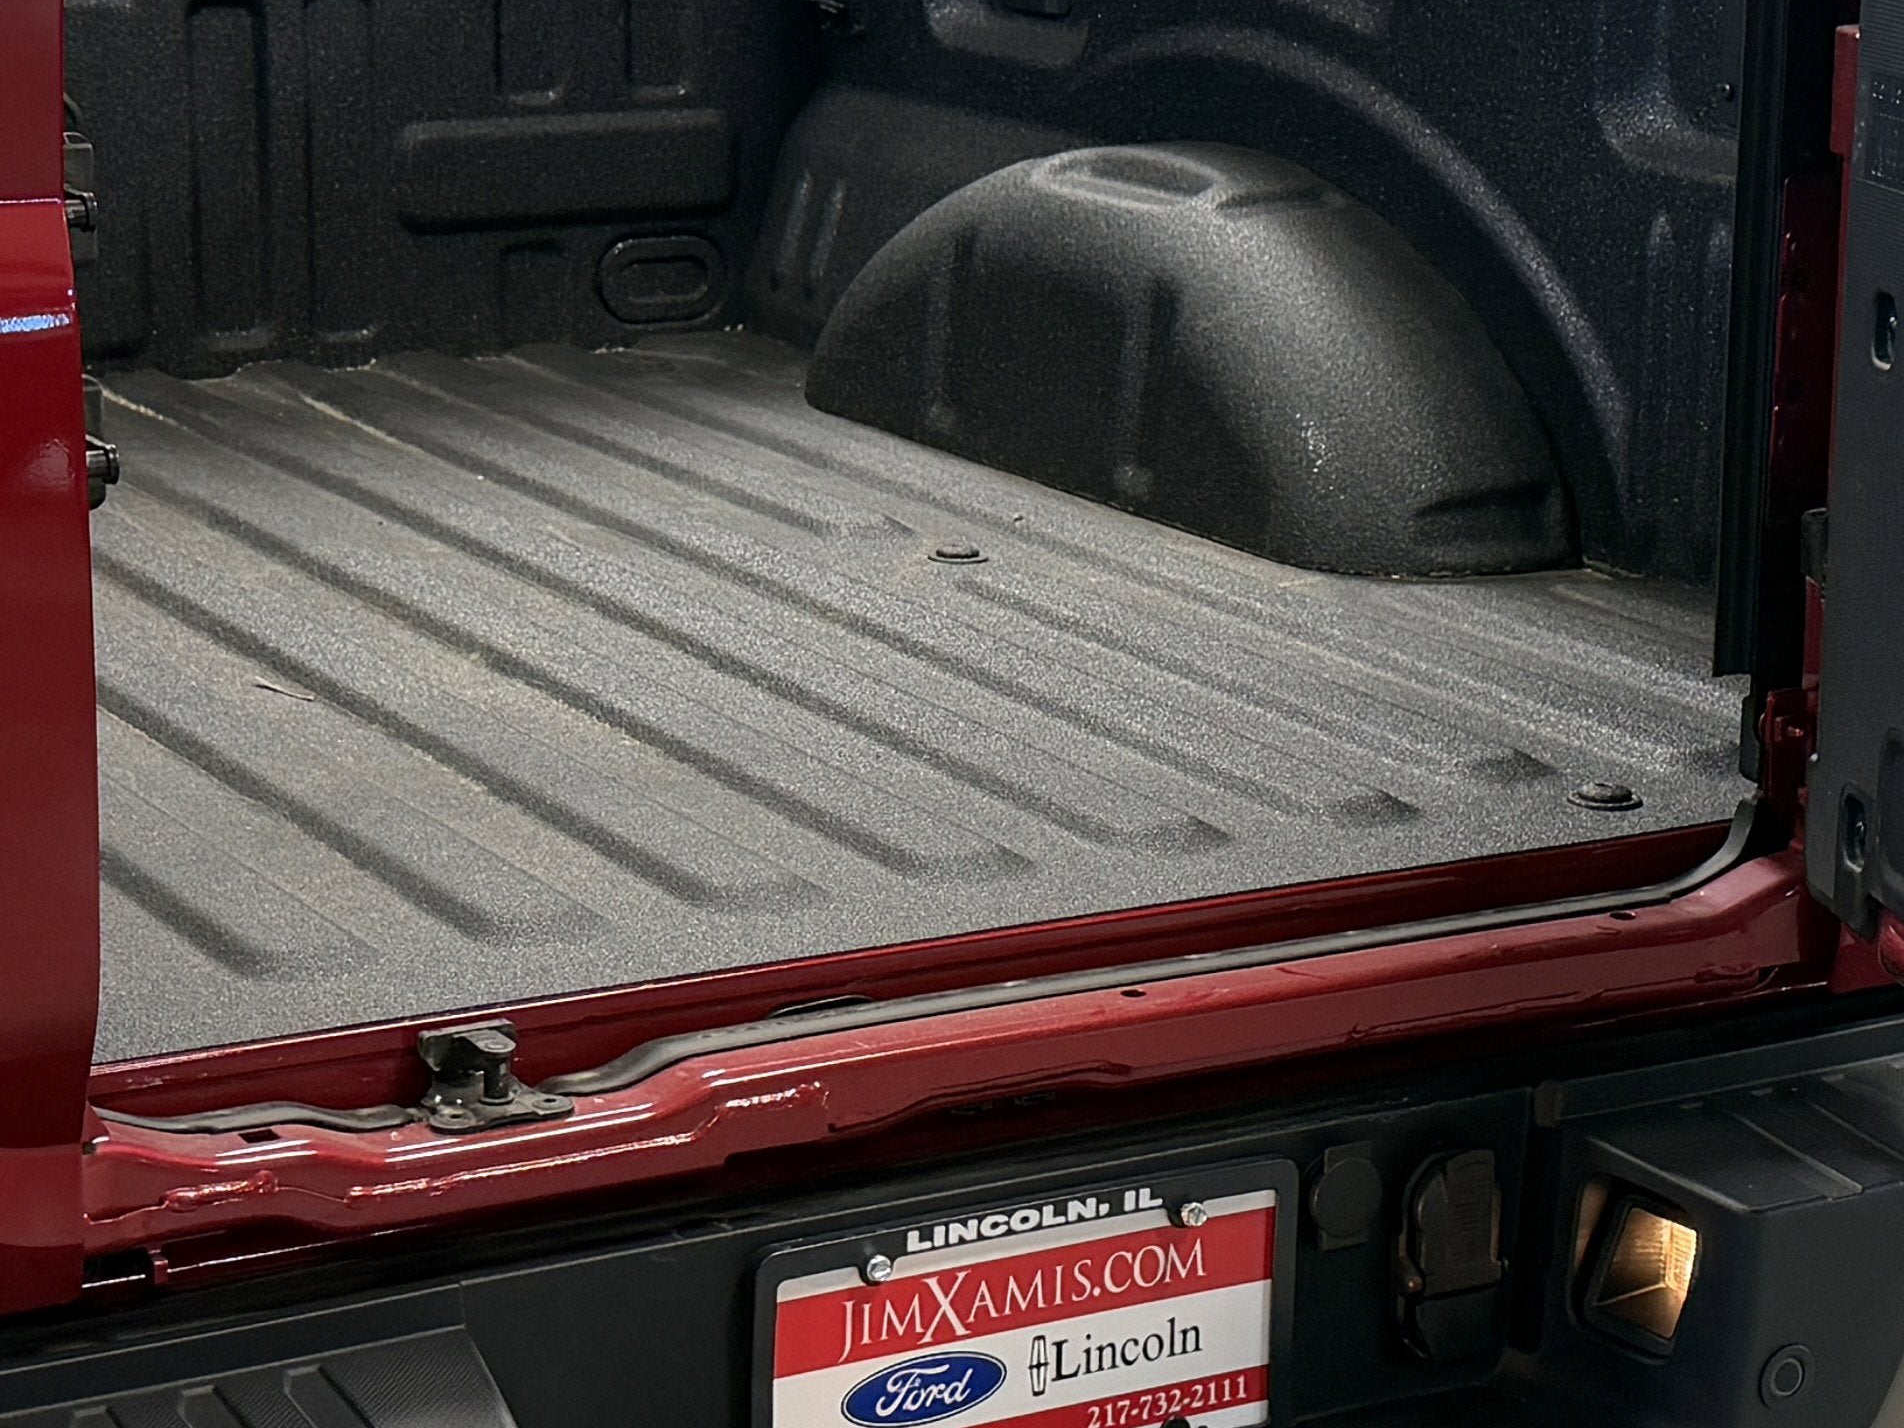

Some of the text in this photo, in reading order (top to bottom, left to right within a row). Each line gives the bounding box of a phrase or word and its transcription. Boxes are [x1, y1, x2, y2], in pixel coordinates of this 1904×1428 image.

[906, 1188, 1164, 1254] LINCOLN, IL
[838, 1237, 1207, 1365] JIMXAMIS.COM
[1050, 1317, 1203, 1383] Lincoln
[875, 1362, 973, 1418] Ford
